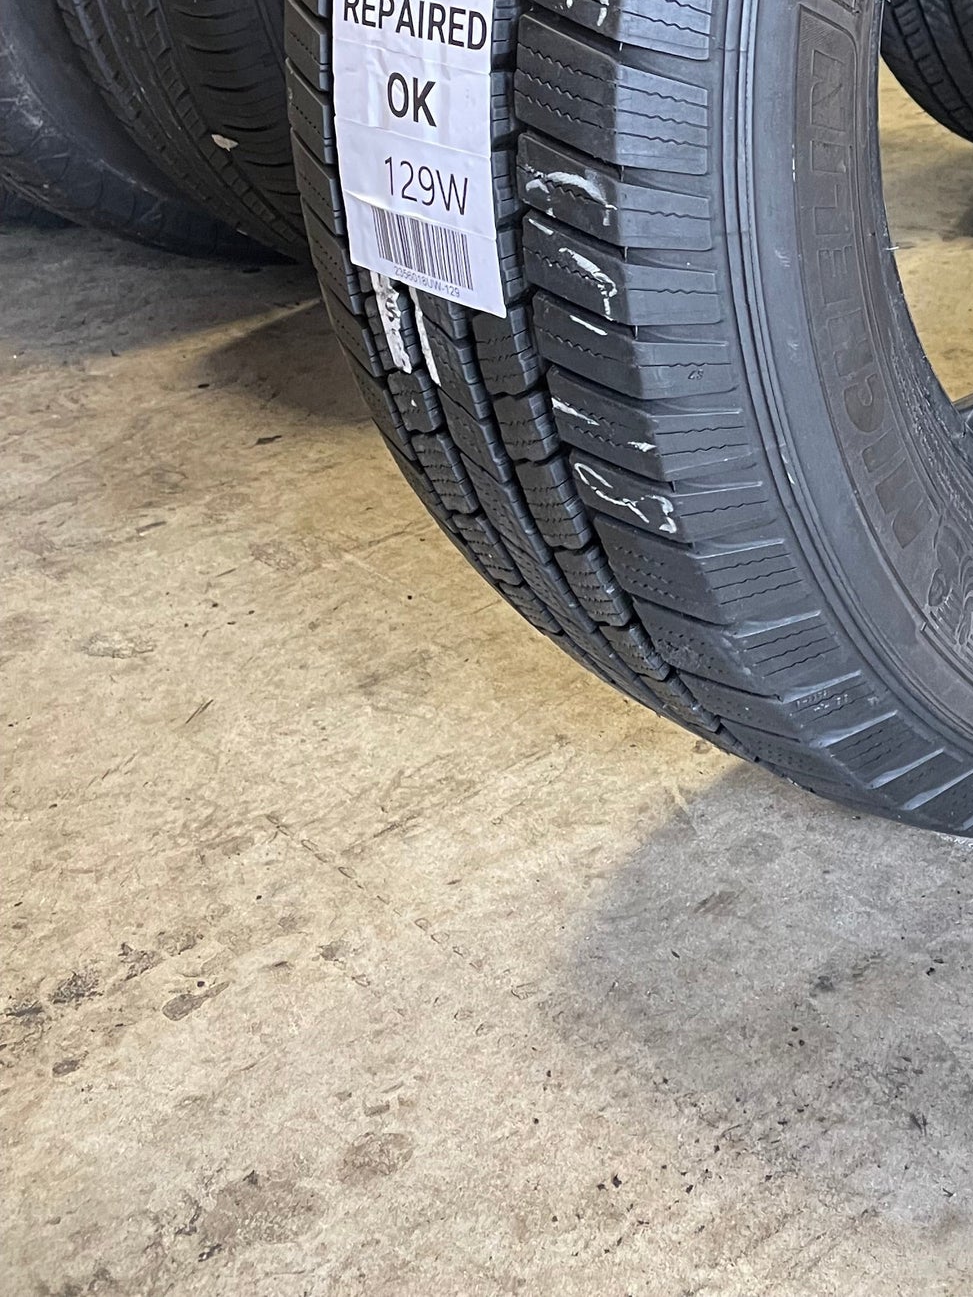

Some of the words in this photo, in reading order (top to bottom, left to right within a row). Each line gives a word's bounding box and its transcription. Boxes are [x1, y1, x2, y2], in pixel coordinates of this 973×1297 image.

[387, 71, 437, 128] OK
[384, 156, 468, 216] 129W
[808, 48, 932, 550] MICHELIN
